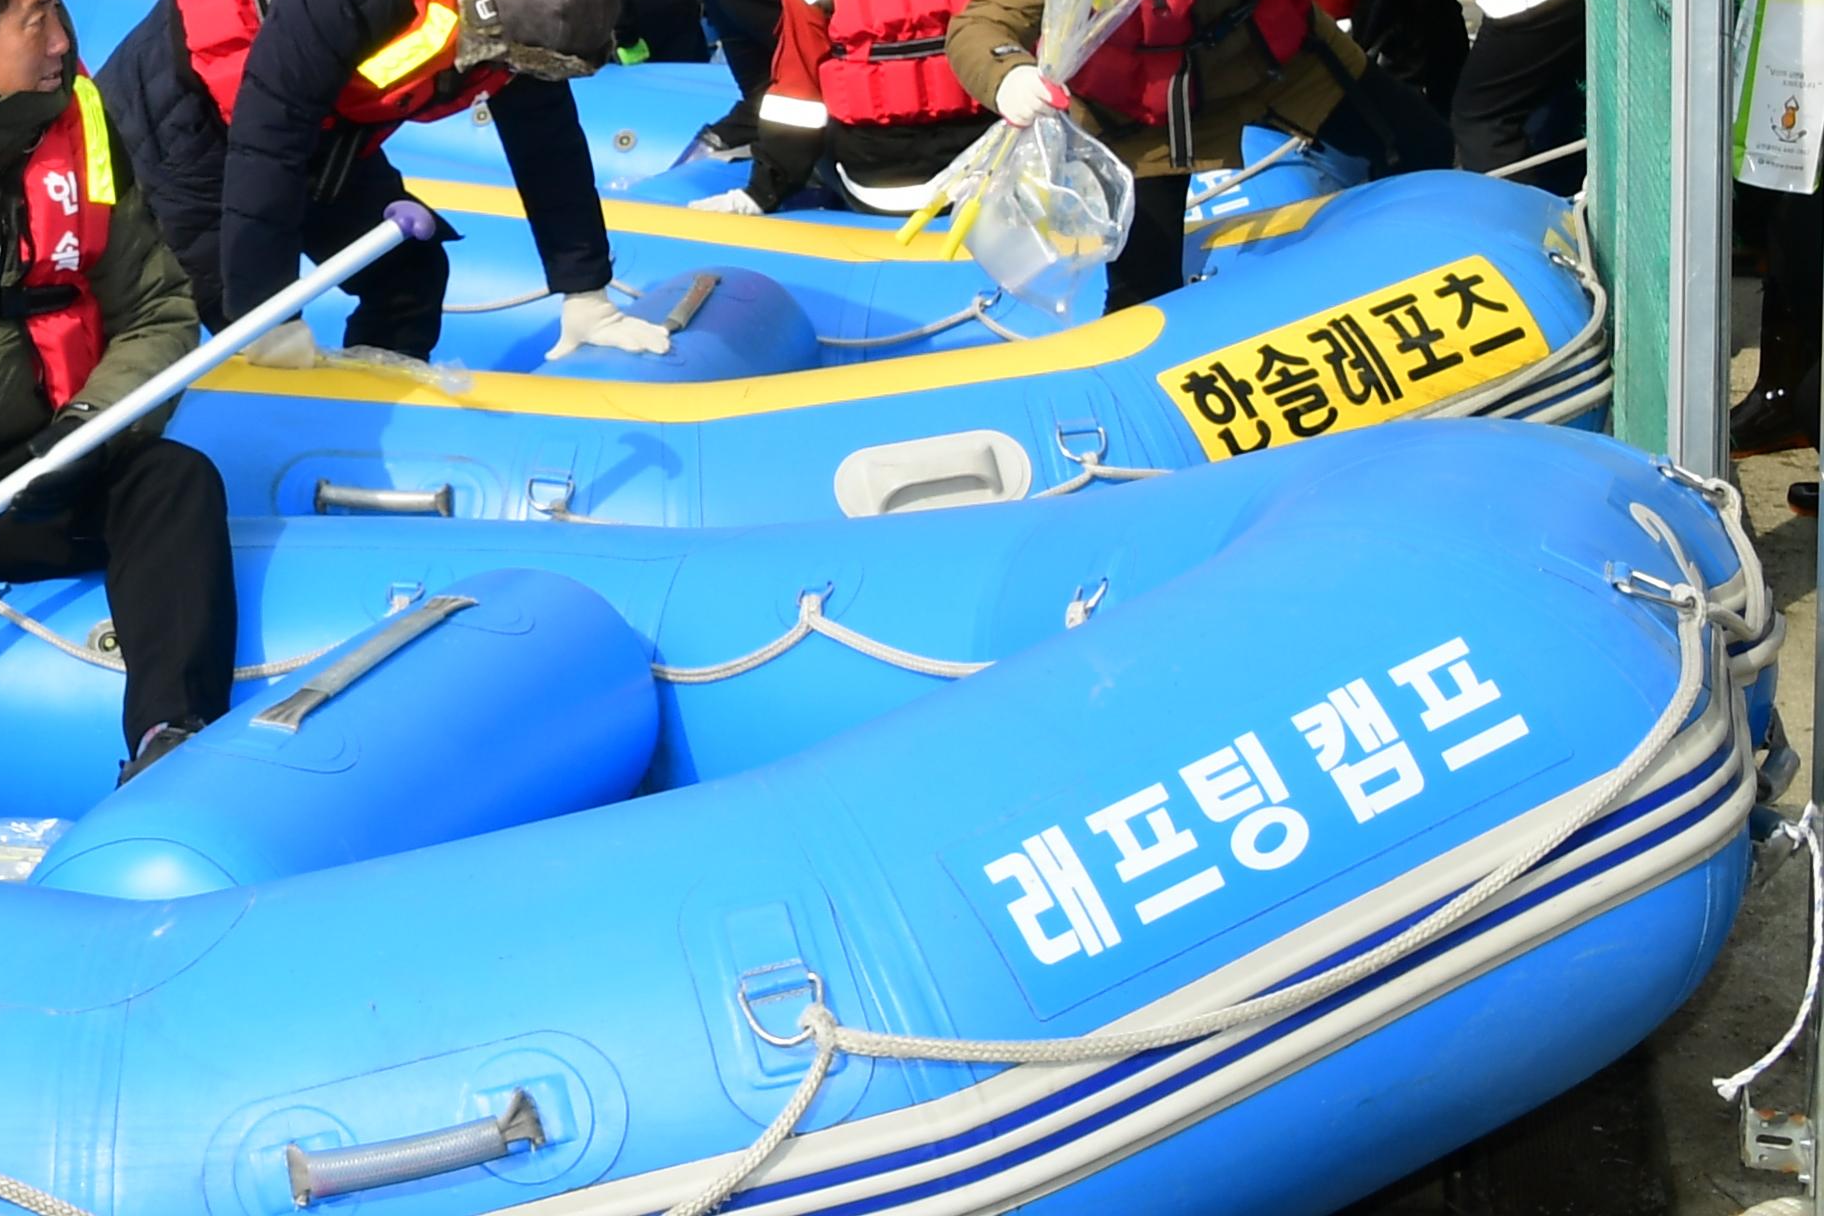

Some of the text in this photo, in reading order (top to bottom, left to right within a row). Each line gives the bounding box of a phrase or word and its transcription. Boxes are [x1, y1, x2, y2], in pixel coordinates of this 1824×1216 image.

[1180, 272, 1526, 455] 한솔레포츠
[983, 637, 1529, 965] 래프팅 캠프
